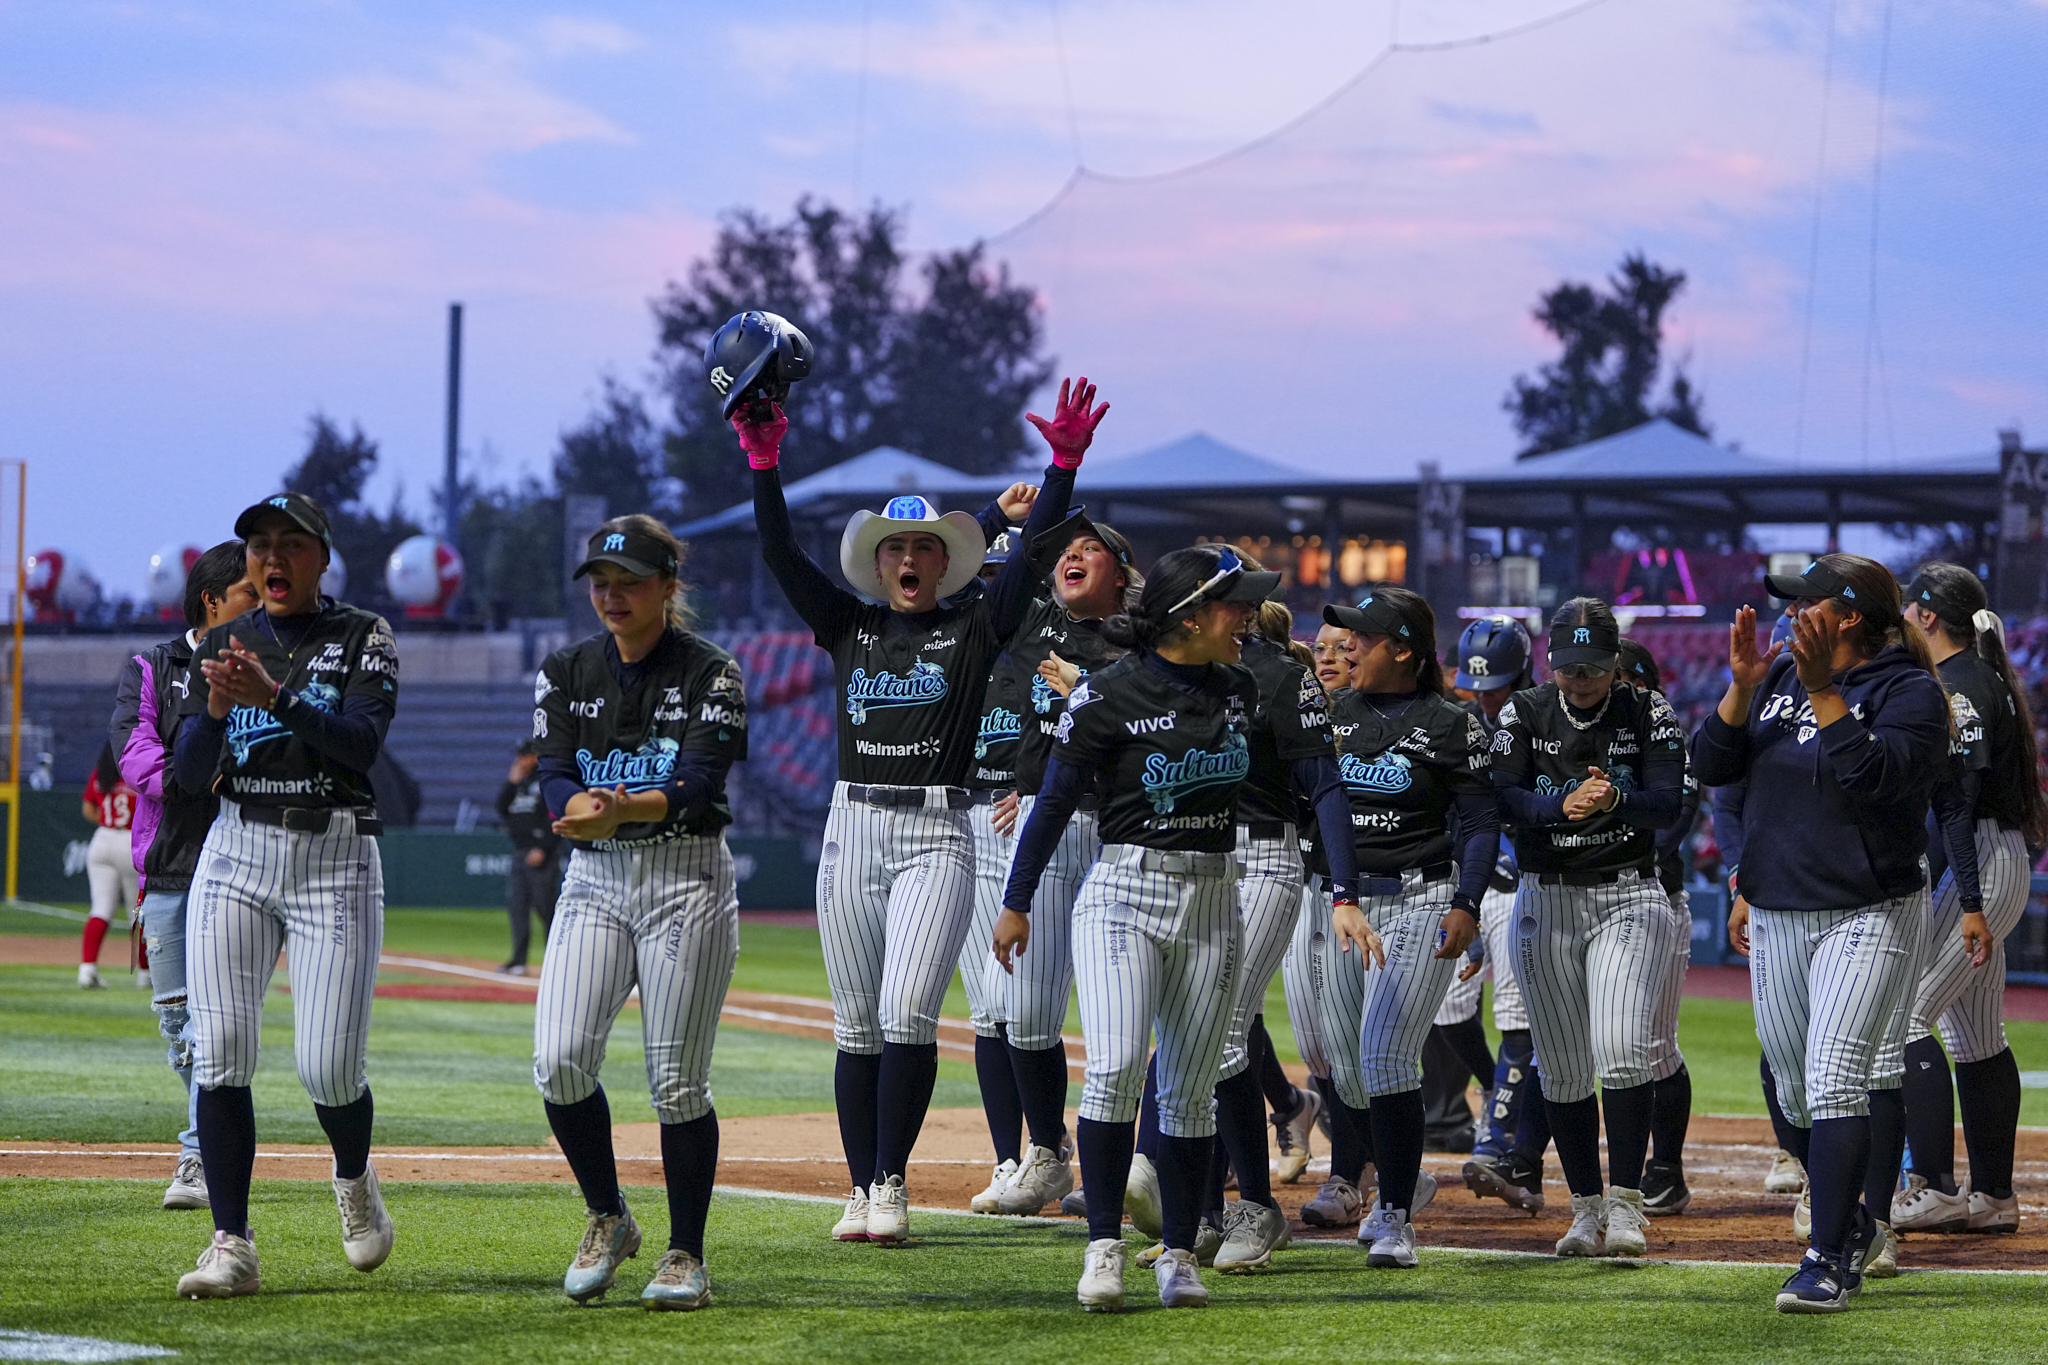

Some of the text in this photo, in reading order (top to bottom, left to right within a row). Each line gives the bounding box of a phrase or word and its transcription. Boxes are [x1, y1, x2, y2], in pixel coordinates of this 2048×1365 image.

[921, 637, 957, 652] ortons
[847, 667, 946, 699] Sultanes
[1410, 726, 1431, 745] Tim
[1616, 727, 1635, 741] Tim
[856, 740, 920, 757] Walmart
[1338, 752, 1412, 787] ltanes
[232, 776, 312, 794] Walmart
[102, 793, 131, 828] 13
[1551, 831, 1615, 848] Walmart
[1521, 938, 1532, 986] DE SEGUROS
[1527, 938, 1535, 973] GENERAL
[1756, 949, 1761, 960] DE
[1760, 950, 1768, 989] GENERAL
